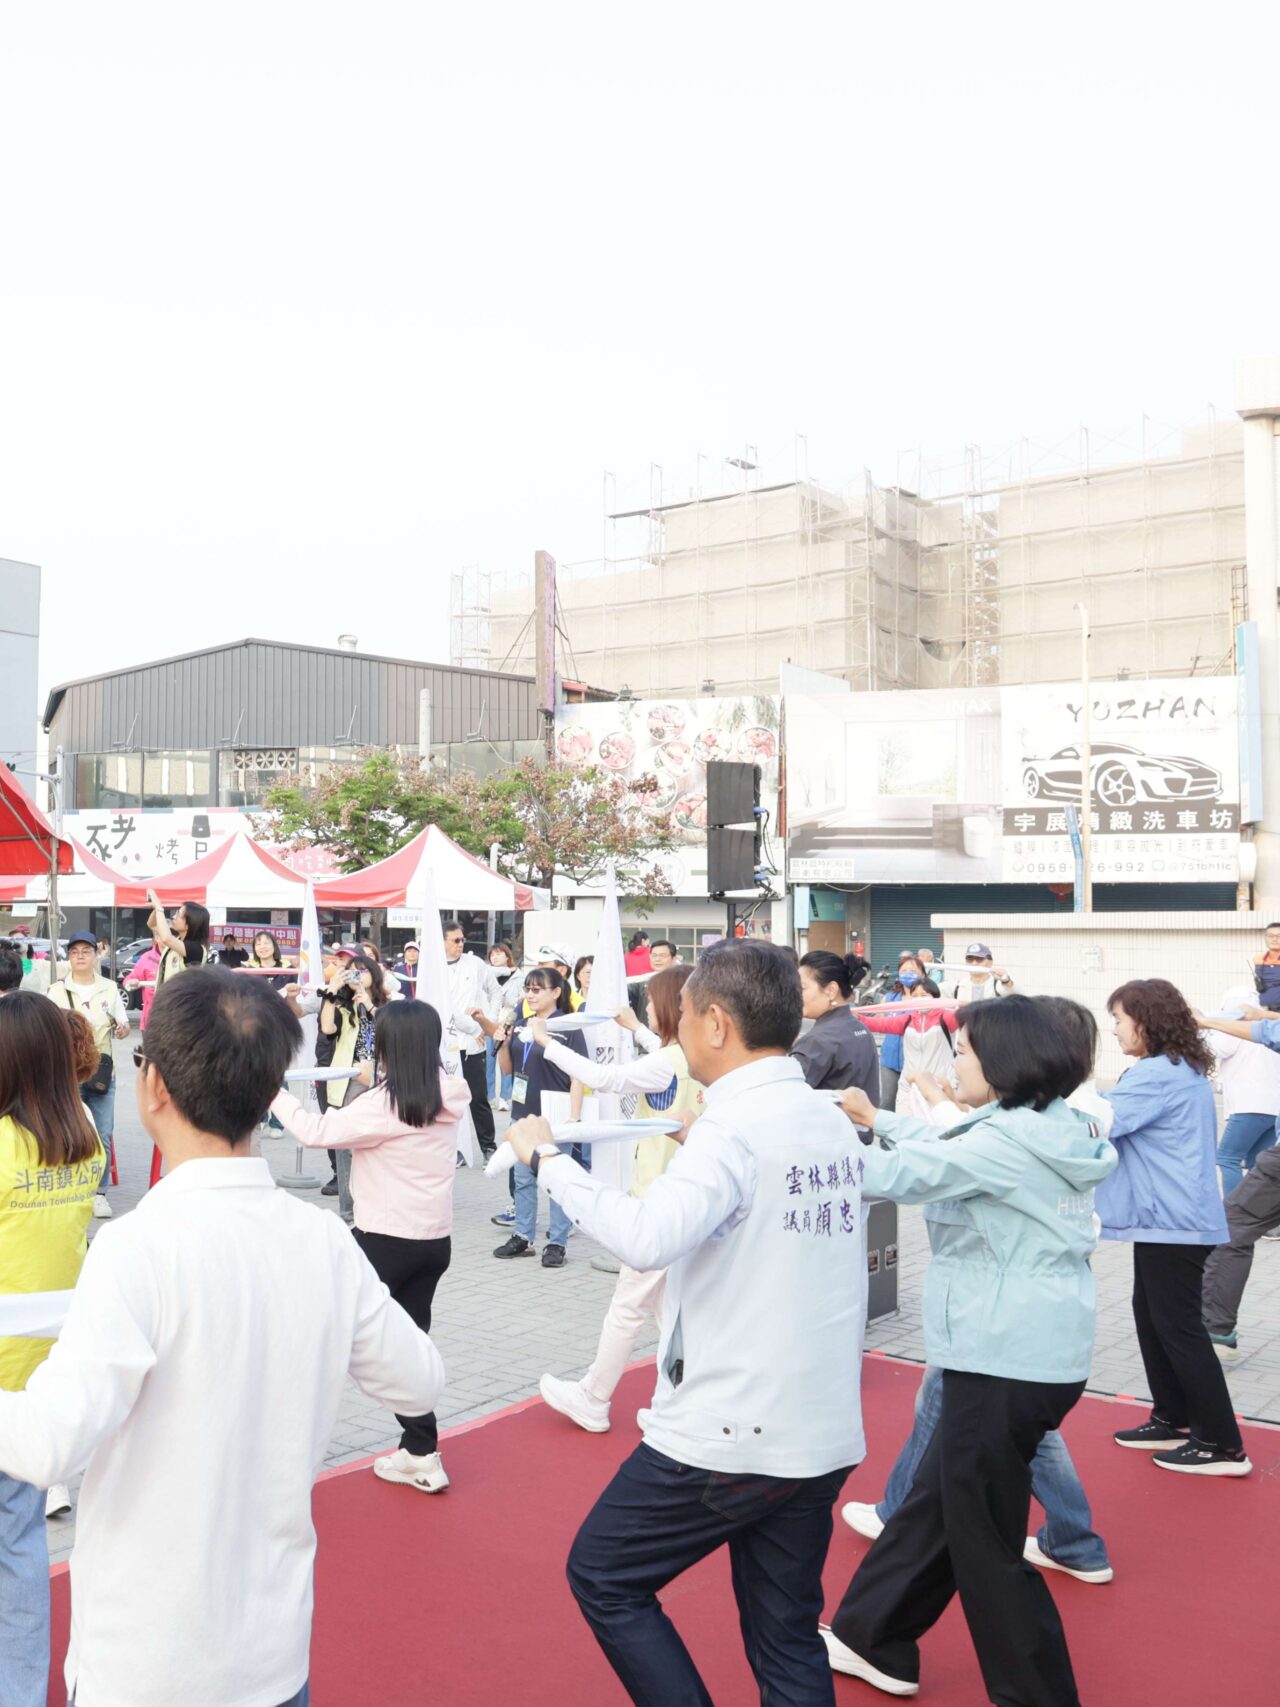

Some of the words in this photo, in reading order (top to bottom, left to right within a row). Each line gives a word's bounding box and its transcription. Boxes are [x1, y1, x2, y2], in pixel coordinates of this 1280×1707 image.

[1066, 696, 1217, 723] YUZHAN
[1027, 862, 1144, 874] 0958-26-992
[13, 1160, 102, 1193] 斗南鎮公所
[10, 1199, 47, 1209] Dounan
